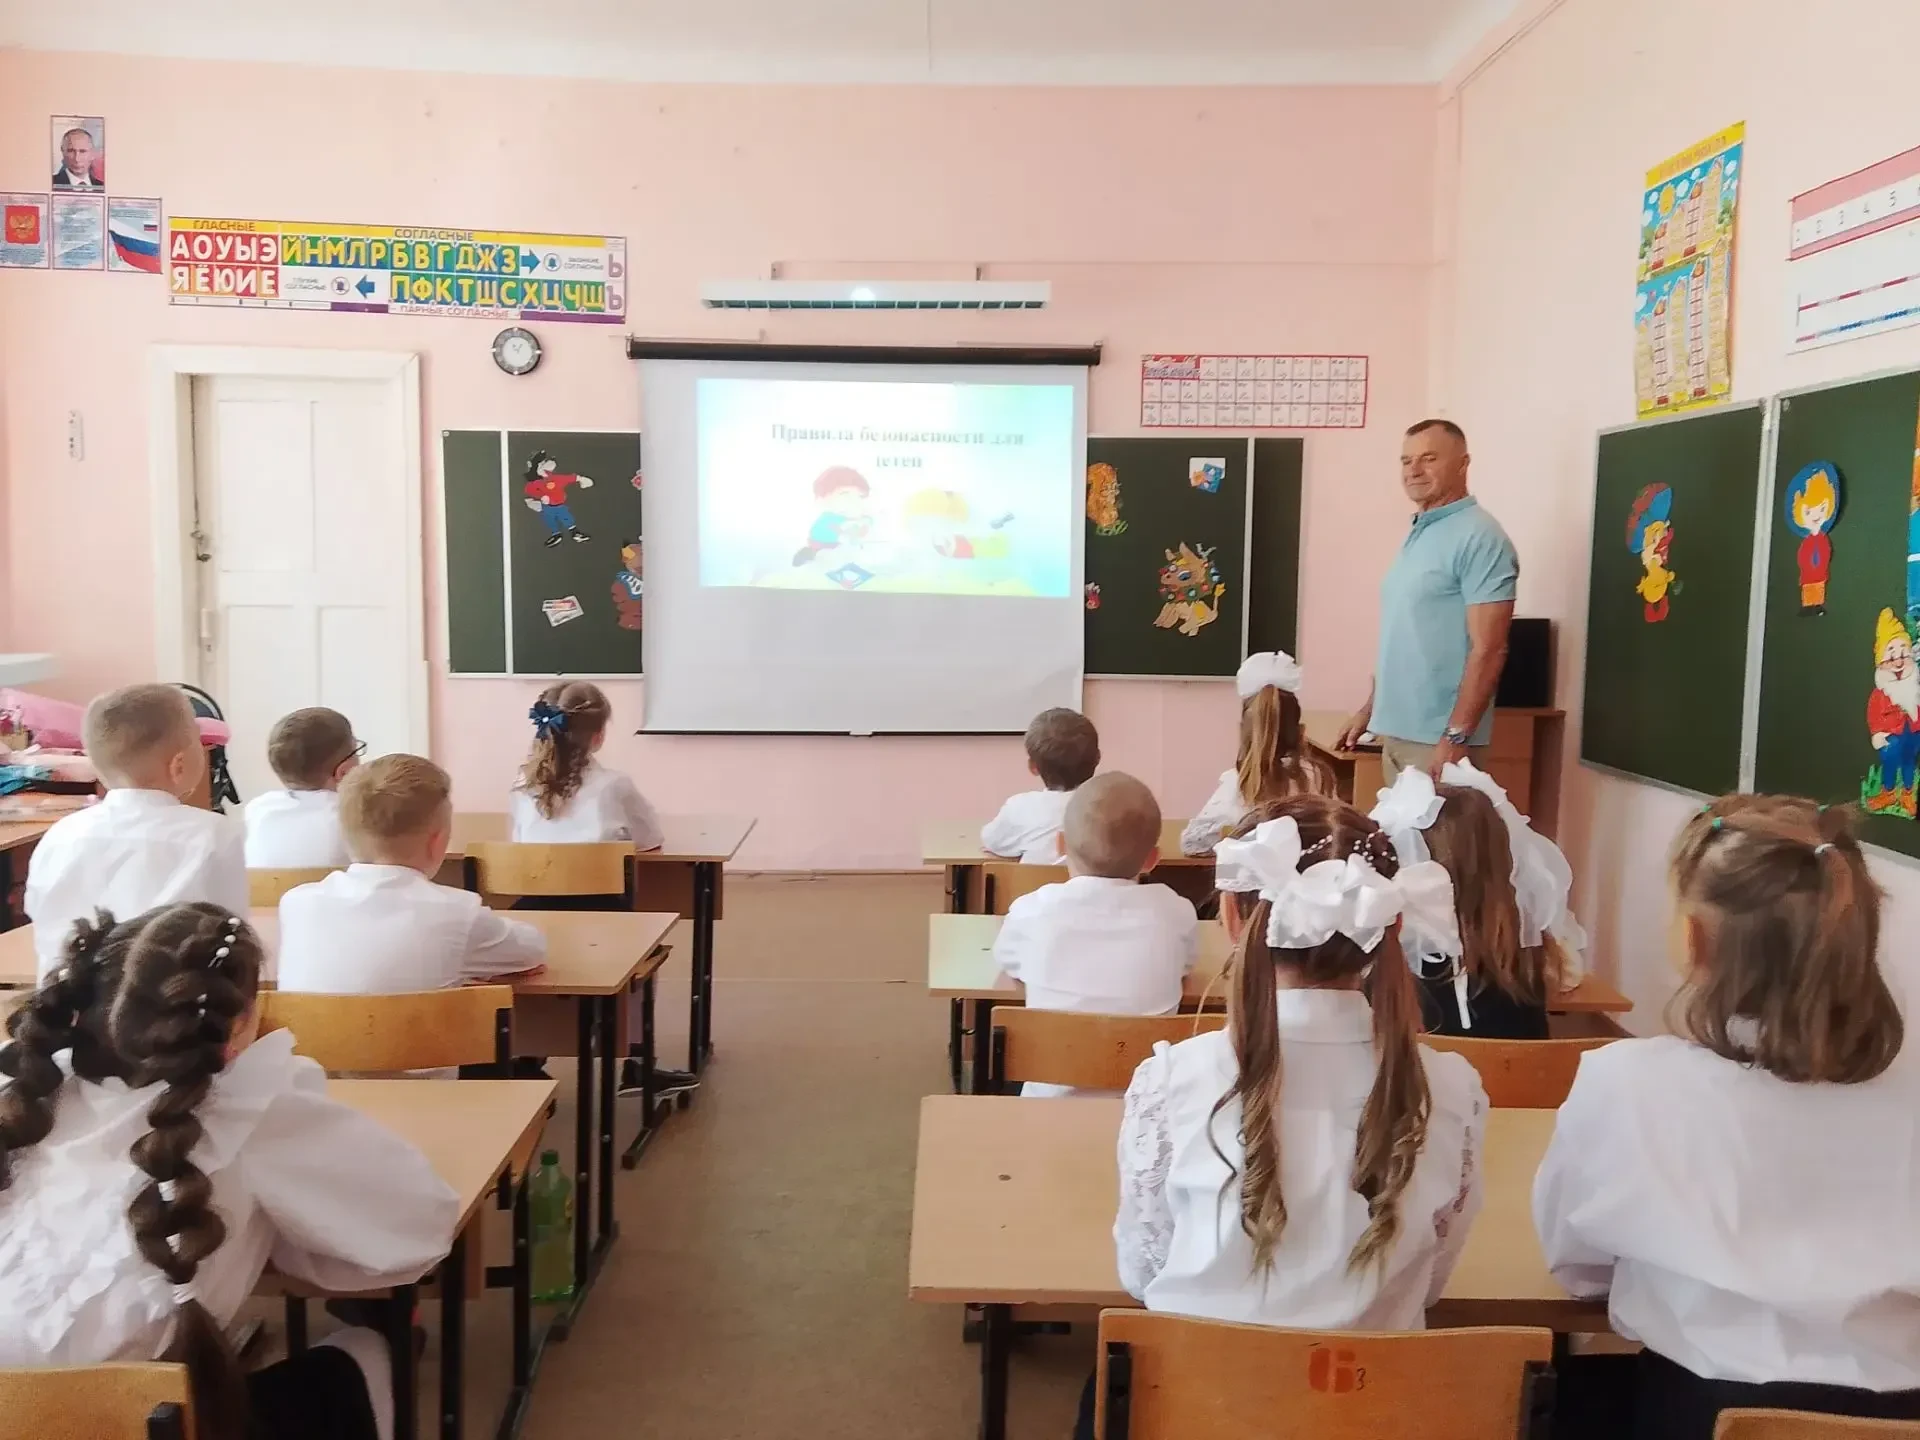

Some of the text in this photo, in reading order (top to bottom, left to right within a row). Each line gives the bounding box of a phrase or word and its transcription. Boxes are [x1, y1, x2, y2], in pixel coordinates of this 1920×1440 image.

[193, 219, 256, 232] ГЛАСНЫЕ
[394, 228, 474, 242] СОГЛАСНЫЕ
[400, 305, 509, 319] ПАРНЫЕ СОГЛАСНЫЕ
[1355, 1367, 1367, 1391] 3
